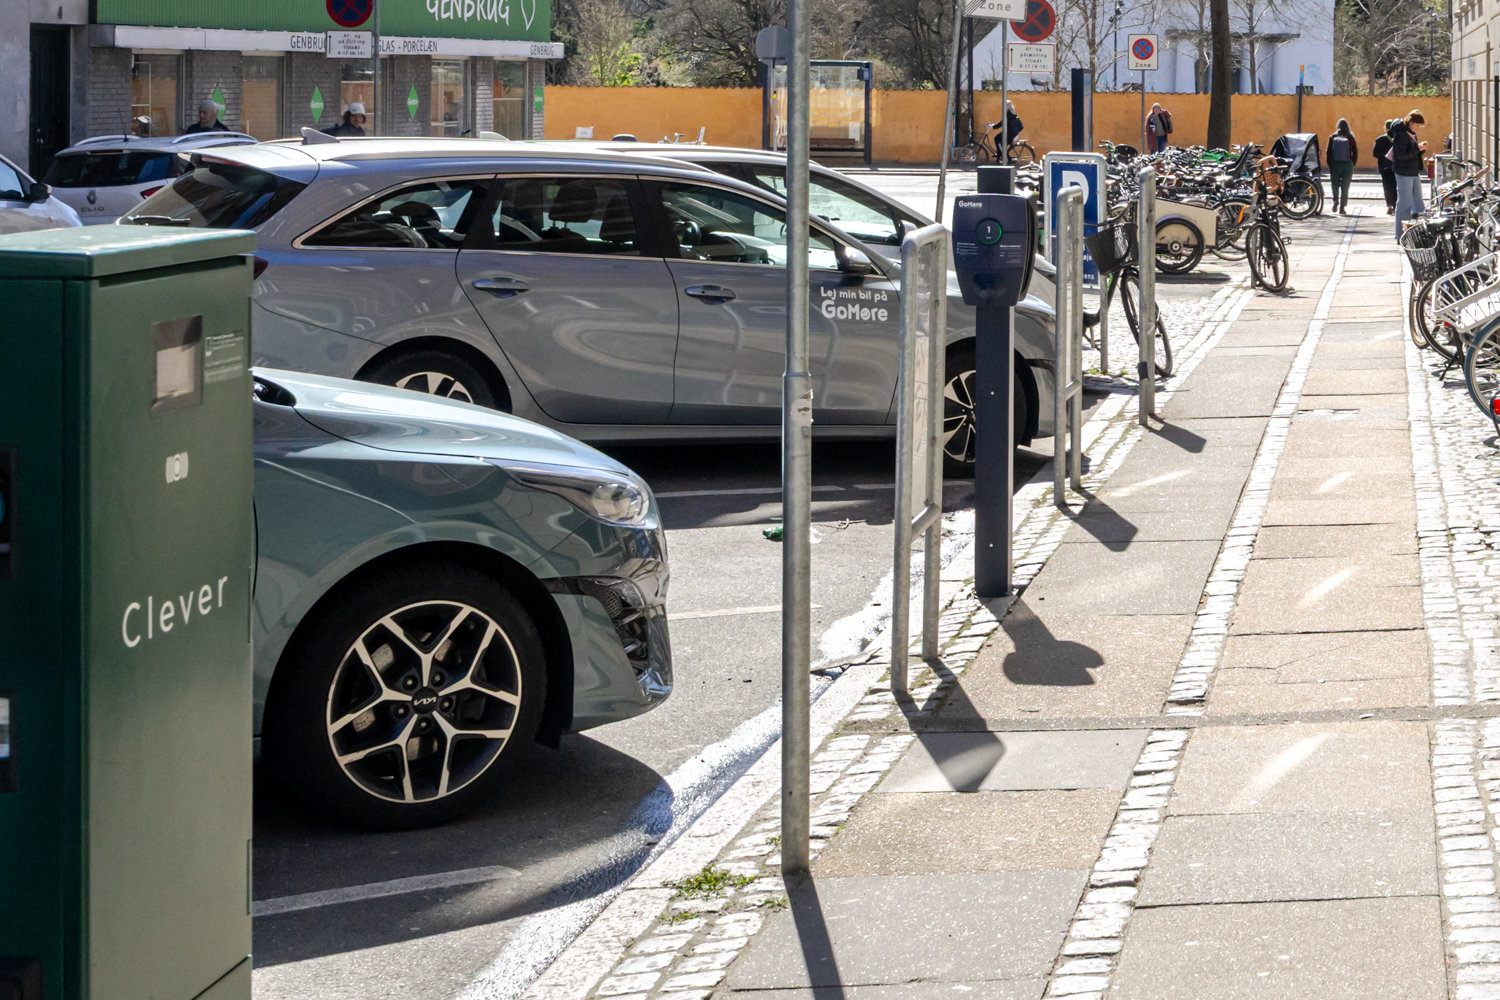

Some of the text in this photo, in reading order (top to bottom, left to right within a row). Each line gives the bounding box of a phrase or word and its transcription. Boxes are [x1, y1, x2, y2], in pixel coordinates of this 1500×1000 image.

[979, 0, 1012, 12] Zone
[403, 39, 438, 52] PORCELÆN
[529, 44, 555, 57] GENBRUG
[820, 286, 888, 303] Lej min bil på
[821, 300, 889, 322] GoMore
[122, 575, 229, 648] Clever
